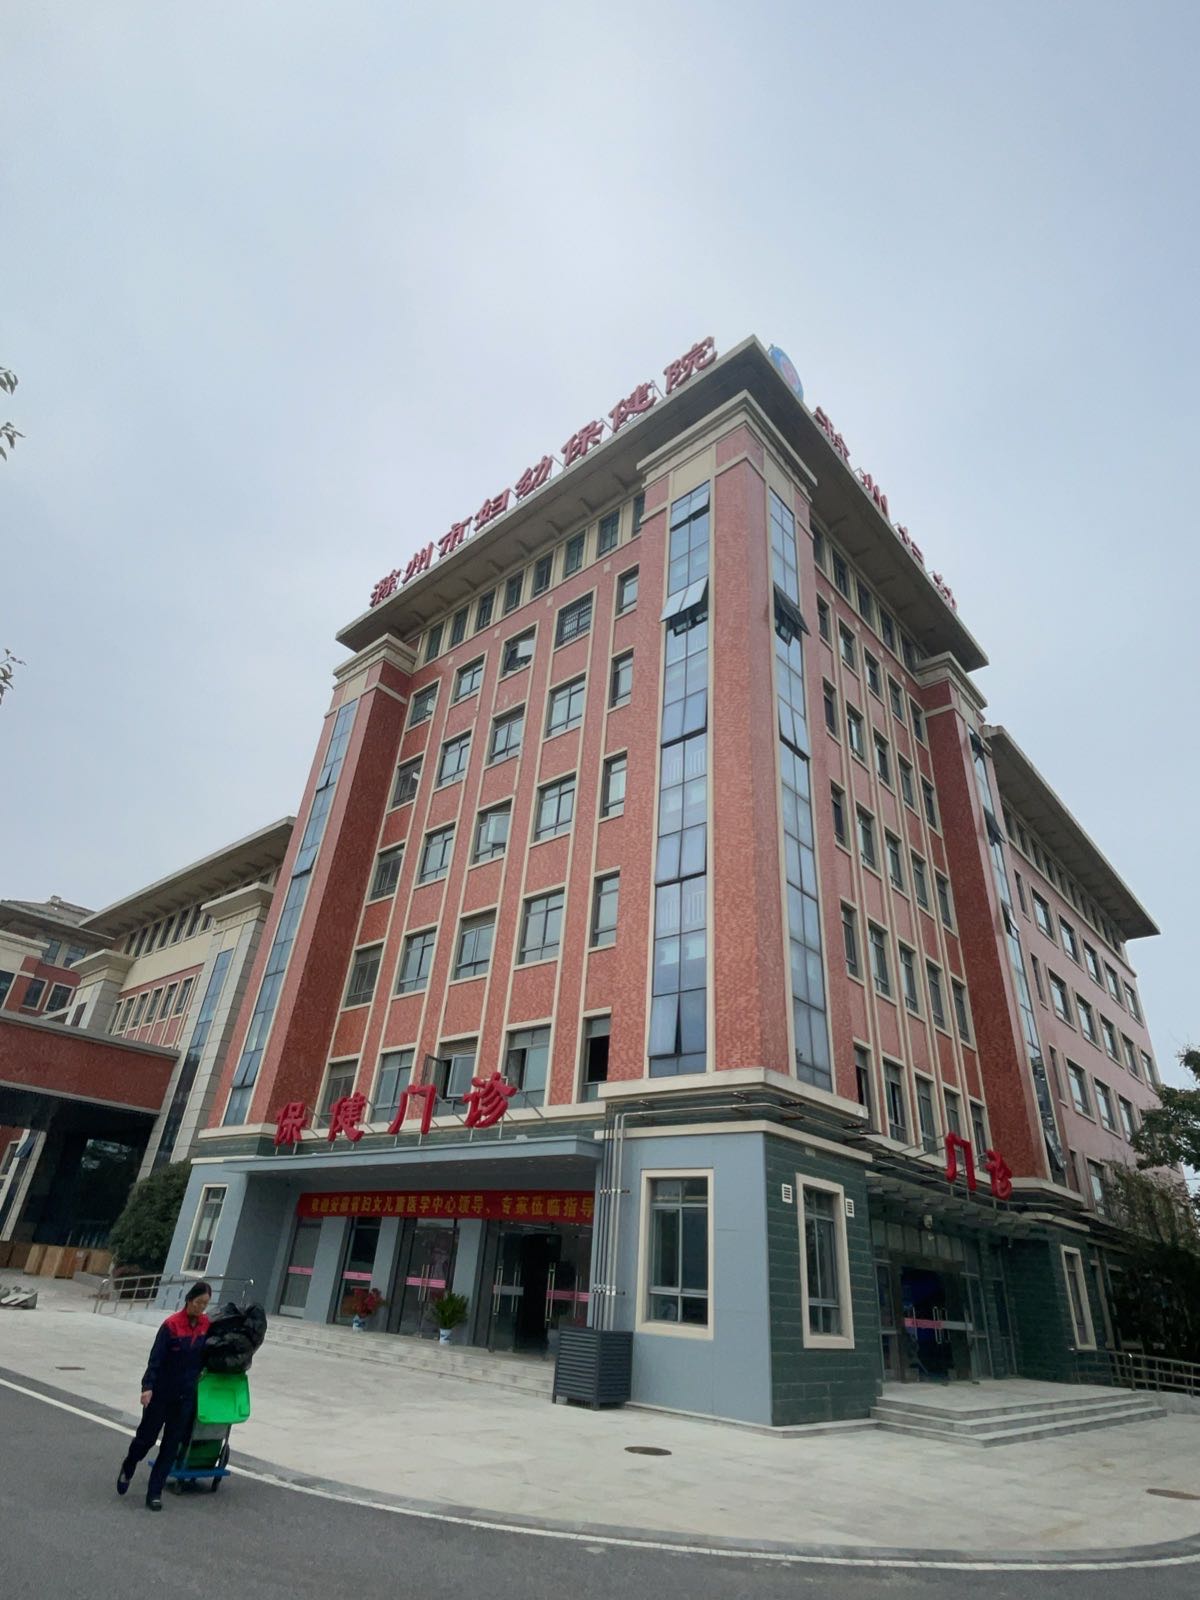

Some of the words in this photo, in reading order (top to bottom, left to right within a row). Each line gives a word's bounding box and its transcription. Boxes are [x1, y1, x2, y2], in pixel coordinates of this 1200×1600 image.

[274, 1073, 516, 1144] 保健门诊
[945, 1132, 1012, 1200] 门诊
